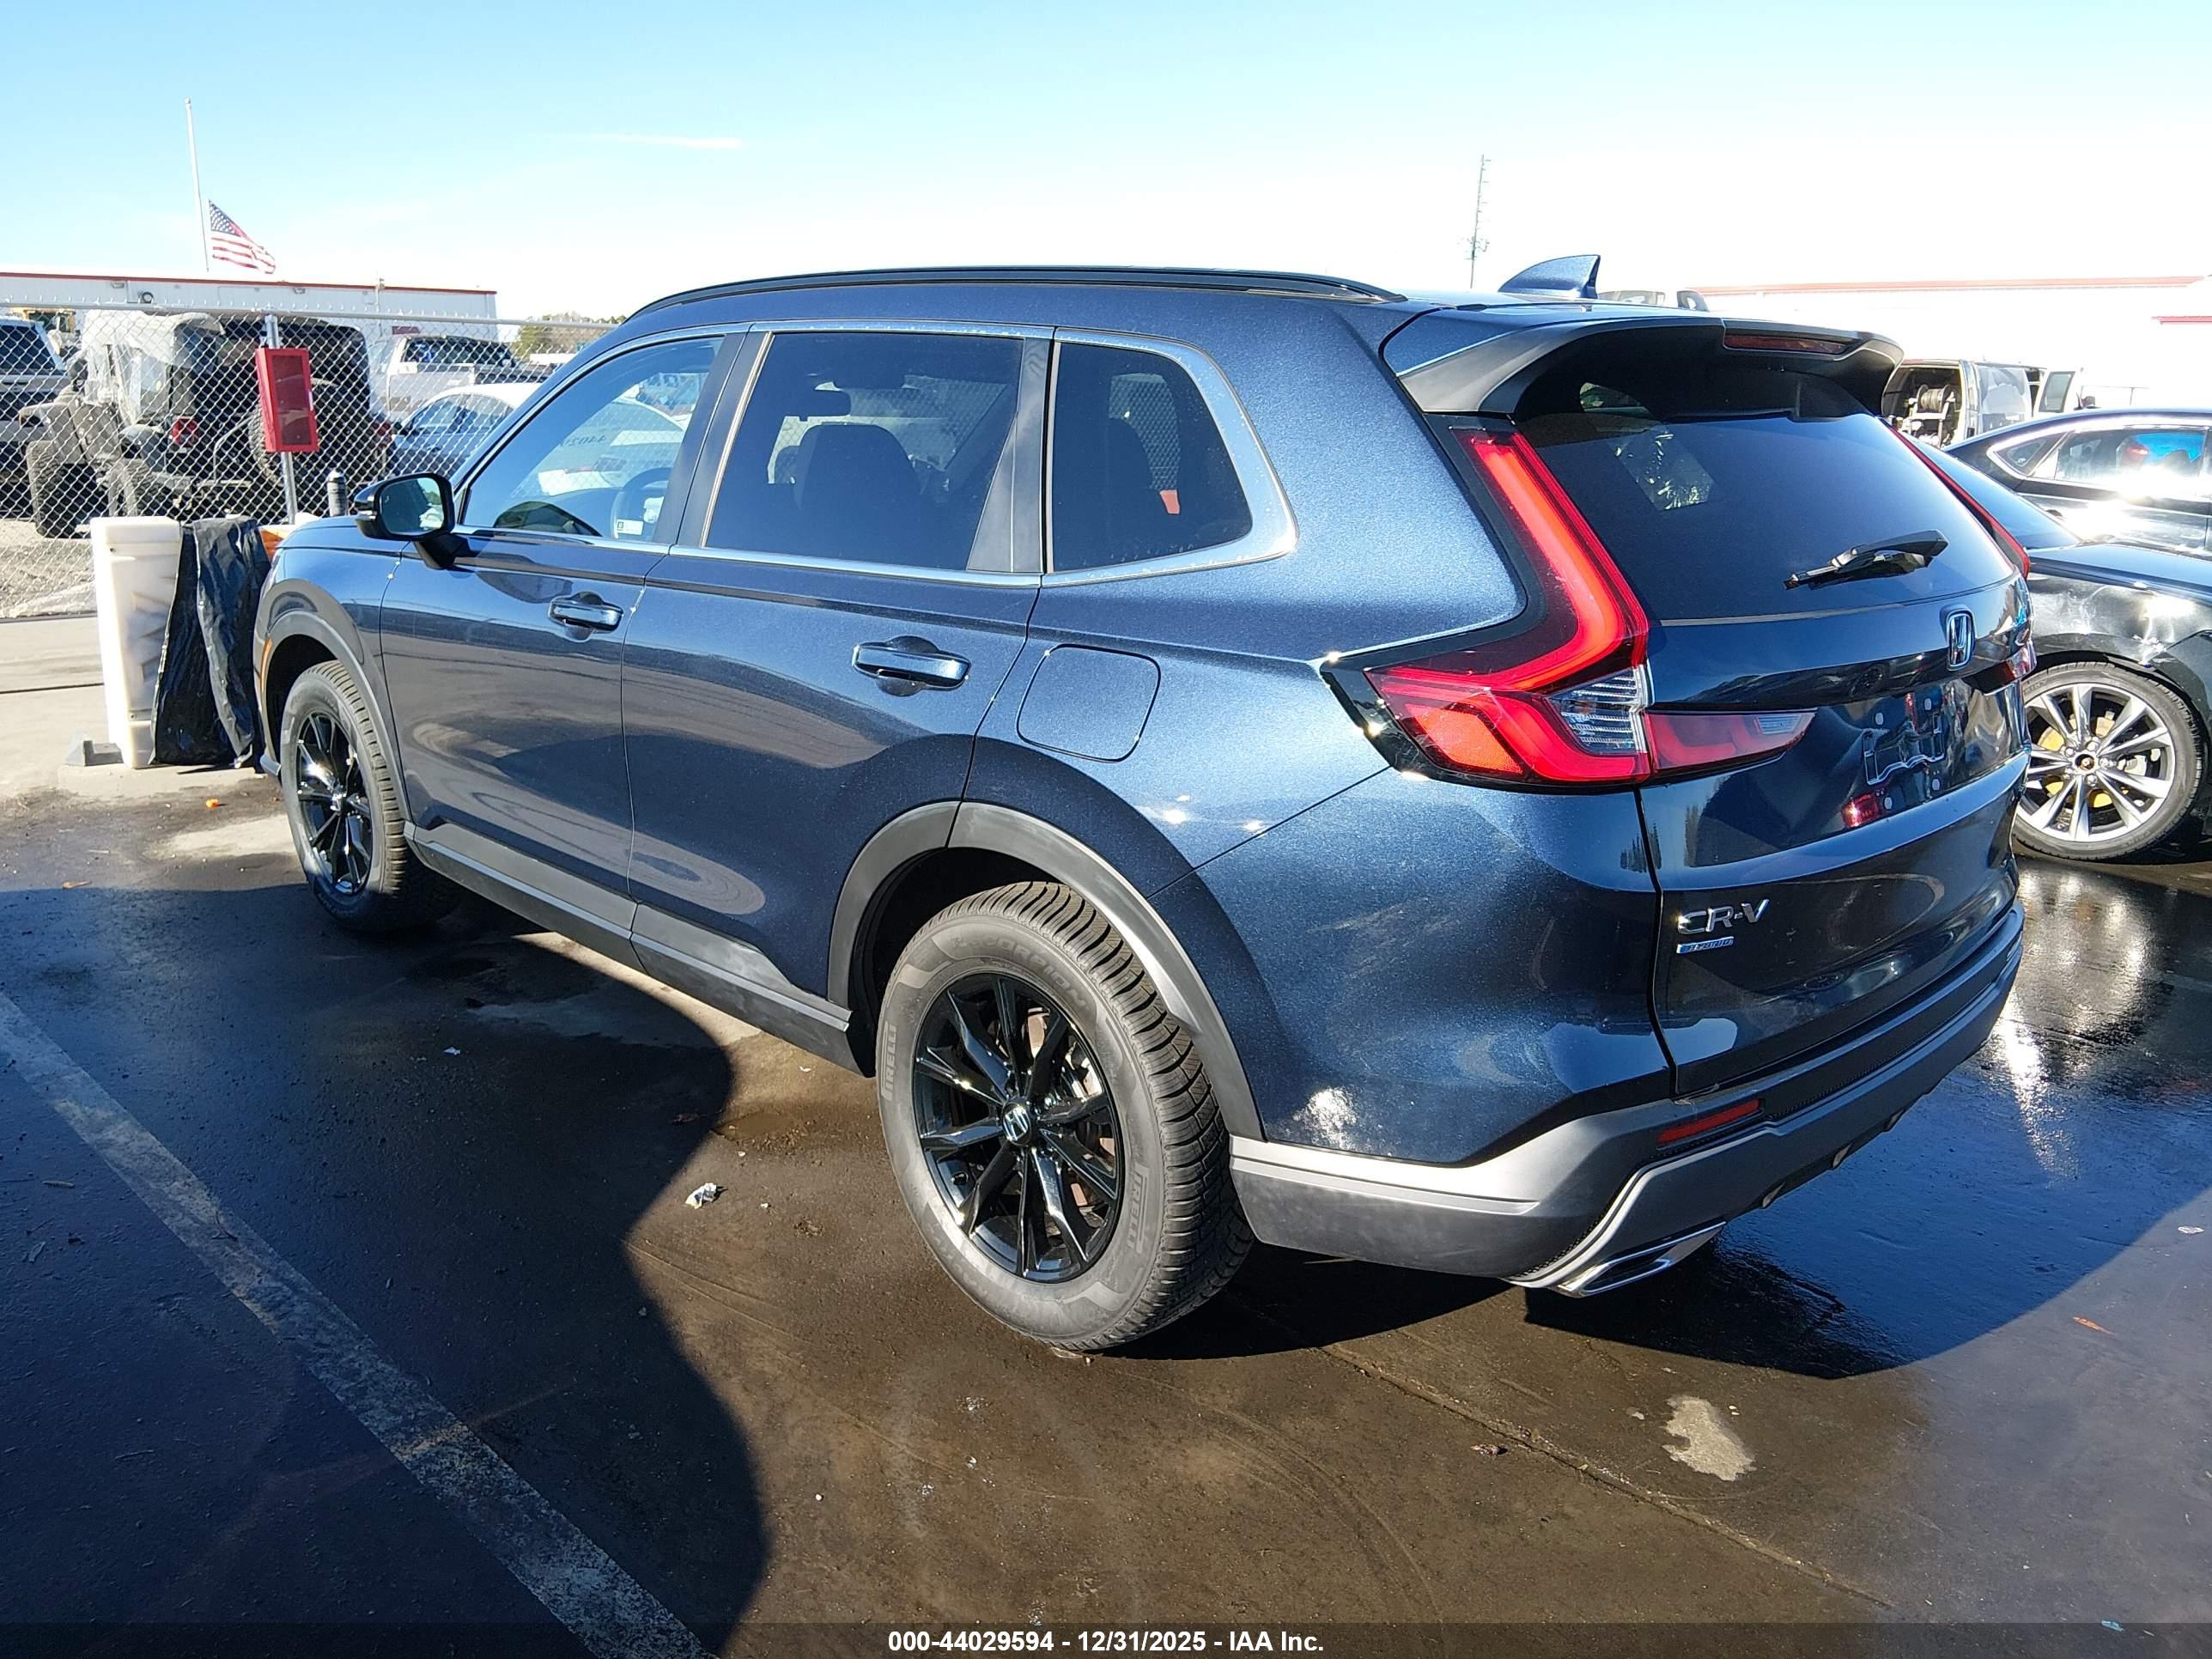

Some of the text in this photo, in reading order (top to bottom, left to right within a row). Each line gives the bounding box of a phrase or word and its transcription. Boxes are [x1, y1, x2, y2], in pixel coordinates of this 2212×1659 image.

[1677, 898, 1771, 935] CR-V
[880, 1020, 896, 1101] PIRELLI
[1127, 1161, 1150, 1255] PIRELLI
